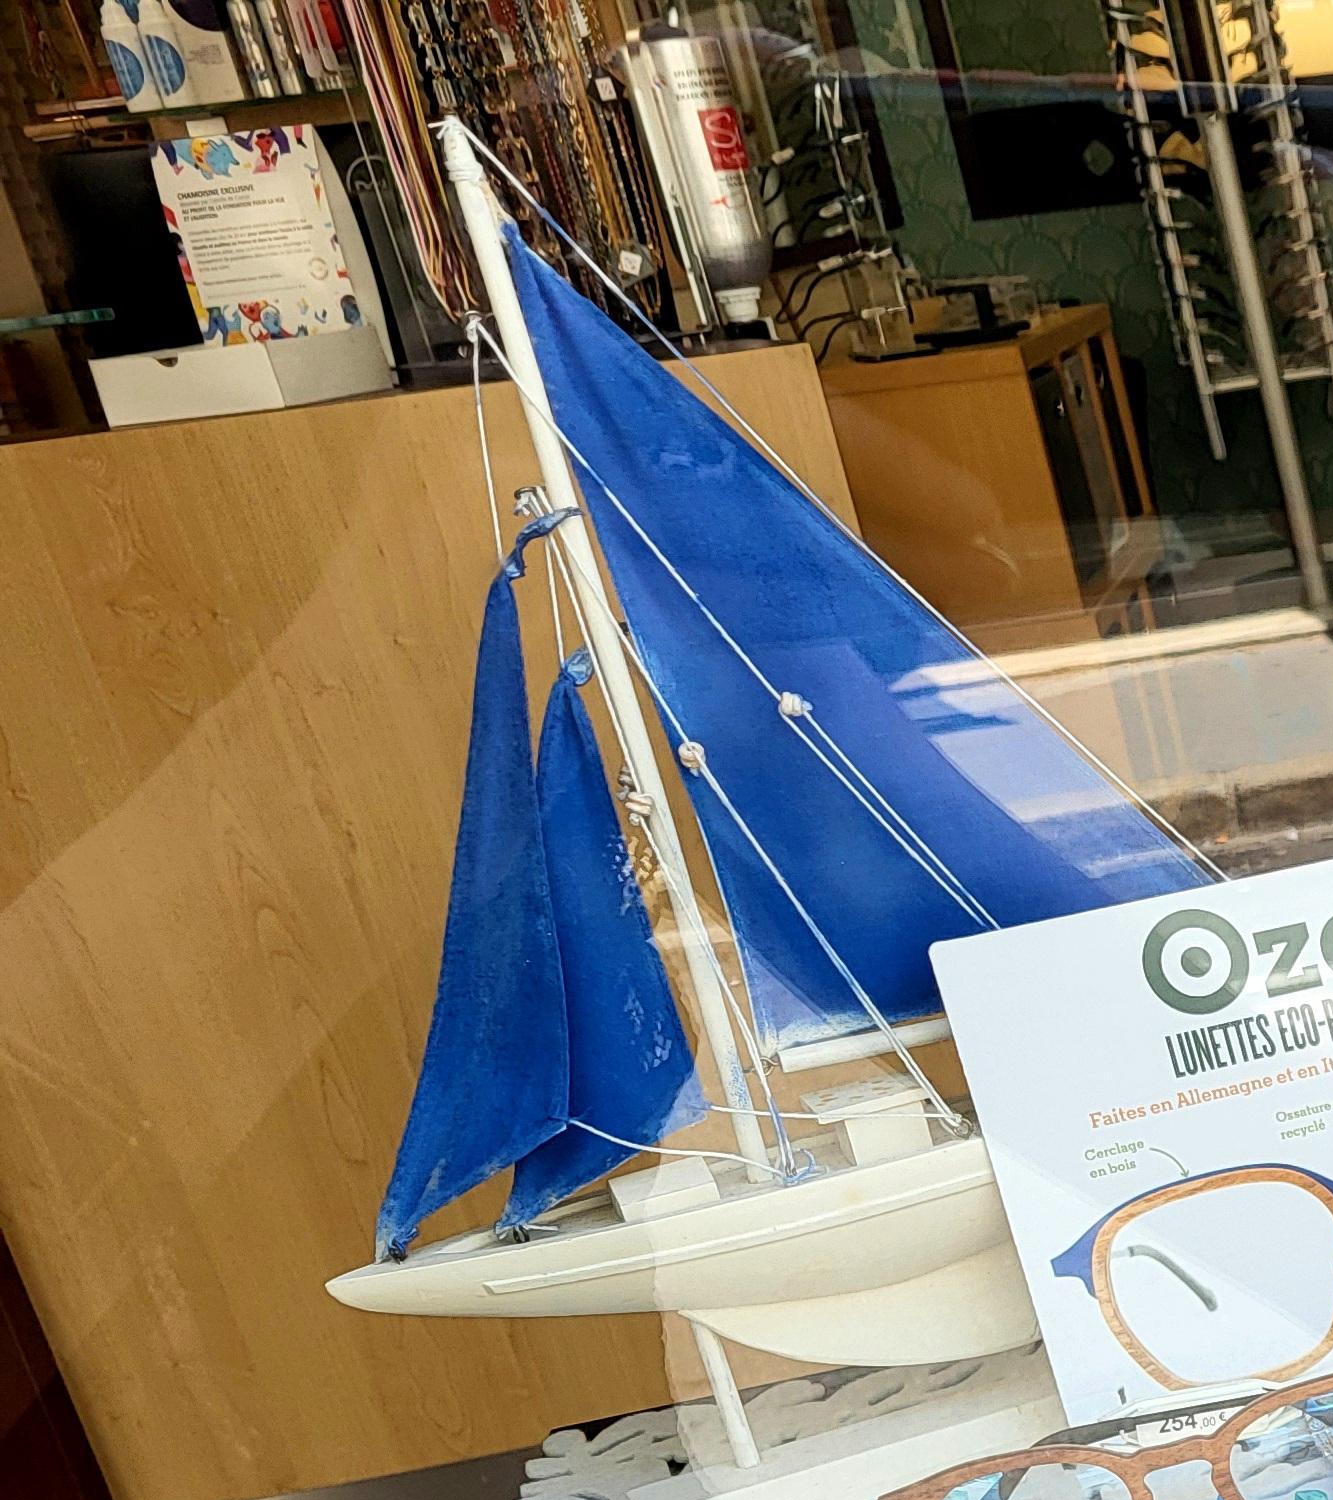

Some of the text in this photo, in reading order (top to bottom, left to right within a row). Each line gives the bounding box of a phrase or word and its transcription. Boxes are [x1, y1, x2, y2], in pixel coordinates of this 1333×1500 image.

[1165, 1013, 1276, 1079] LUNETTES
[1089, 1106, 1147, 1129] Faites
[1149, 1100, 1174, 1115] en
[1176, 1077, 1273, 1109] Allemagne
[1276, 1068, 1294, 1084] et
[1297, 1065, 1320, 1079] en
[1275, 1102, 1332, 1123] Ossature
[1280, 1118, 1326, 1140] recyclé
[1084, 1140, 1145, 1162] Cerclage
[1089, 1158, 1137, 1179] en bois
[1219, 1411, 1227, 1421] €
